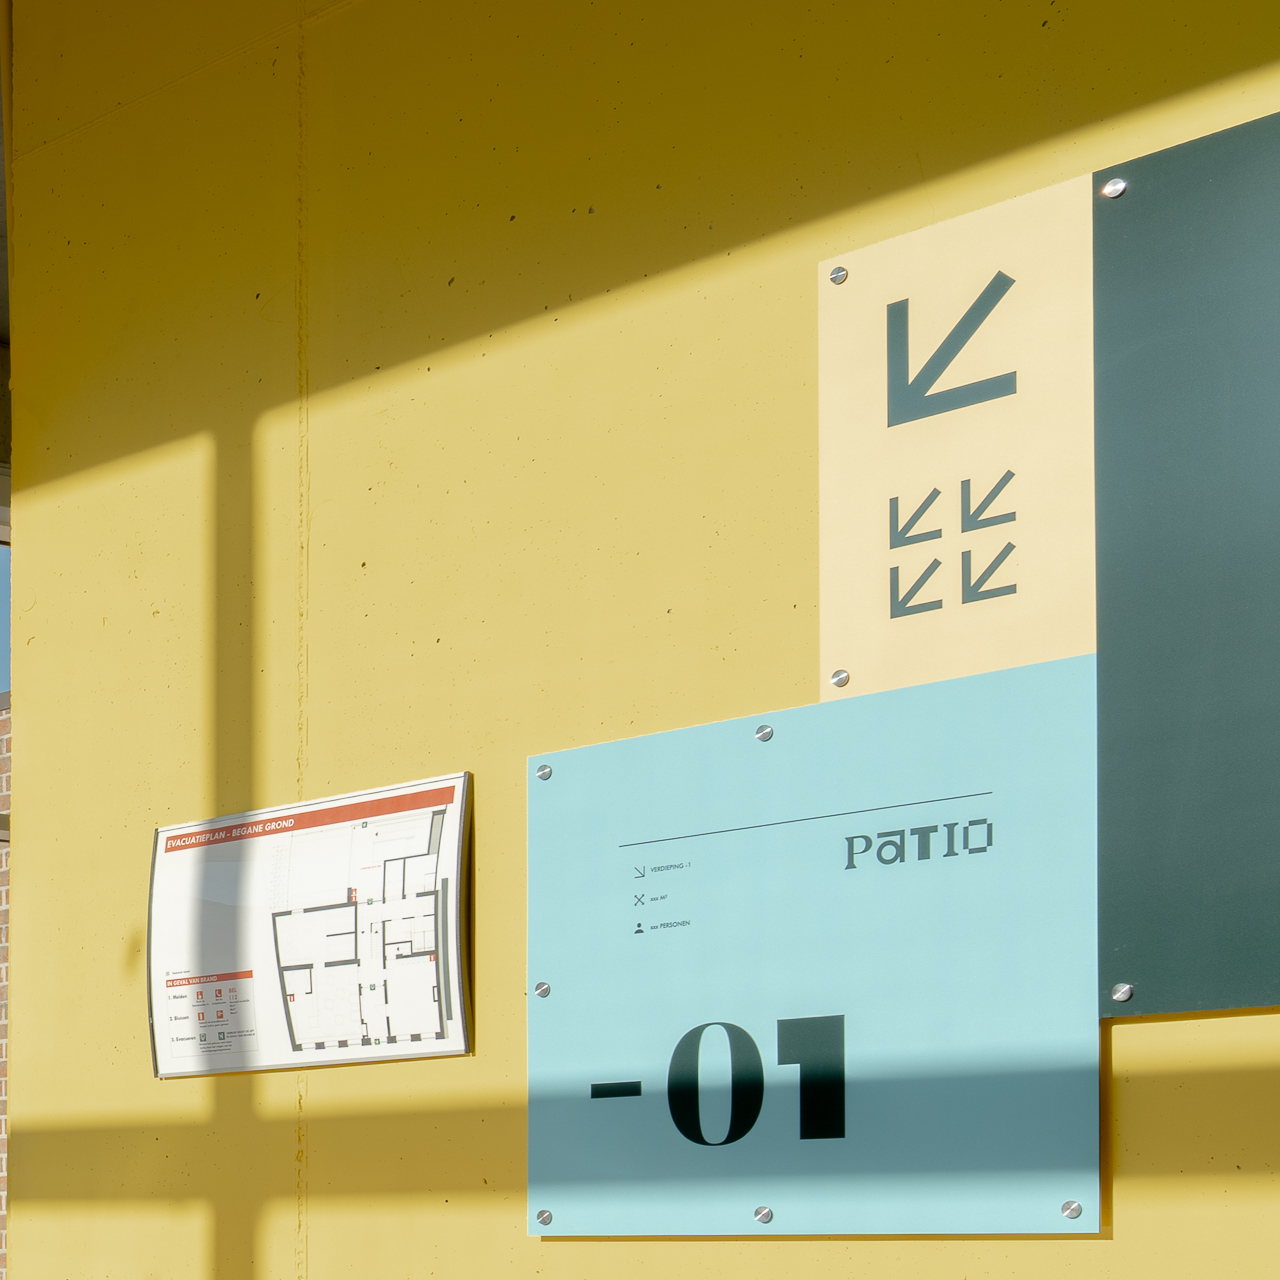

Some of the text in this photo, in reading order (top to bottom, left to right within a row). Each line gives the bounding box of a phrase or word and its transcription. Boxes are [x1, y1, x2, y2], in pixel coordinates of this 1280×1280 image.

[167, 830, 226, 849] EVACUATIEPLAN
[232, 824, 264, 837] BEGANE
[264, 819, 295, 831] GROND
[650, 862, 684, 873] VERDIEPING
[659, 920, 691, 929] PERSONEN
[173, 978, 189, 986] GEVAL
[200, 975, 218, 983] BRAND
[590, 1014, 846, 1147] -01
